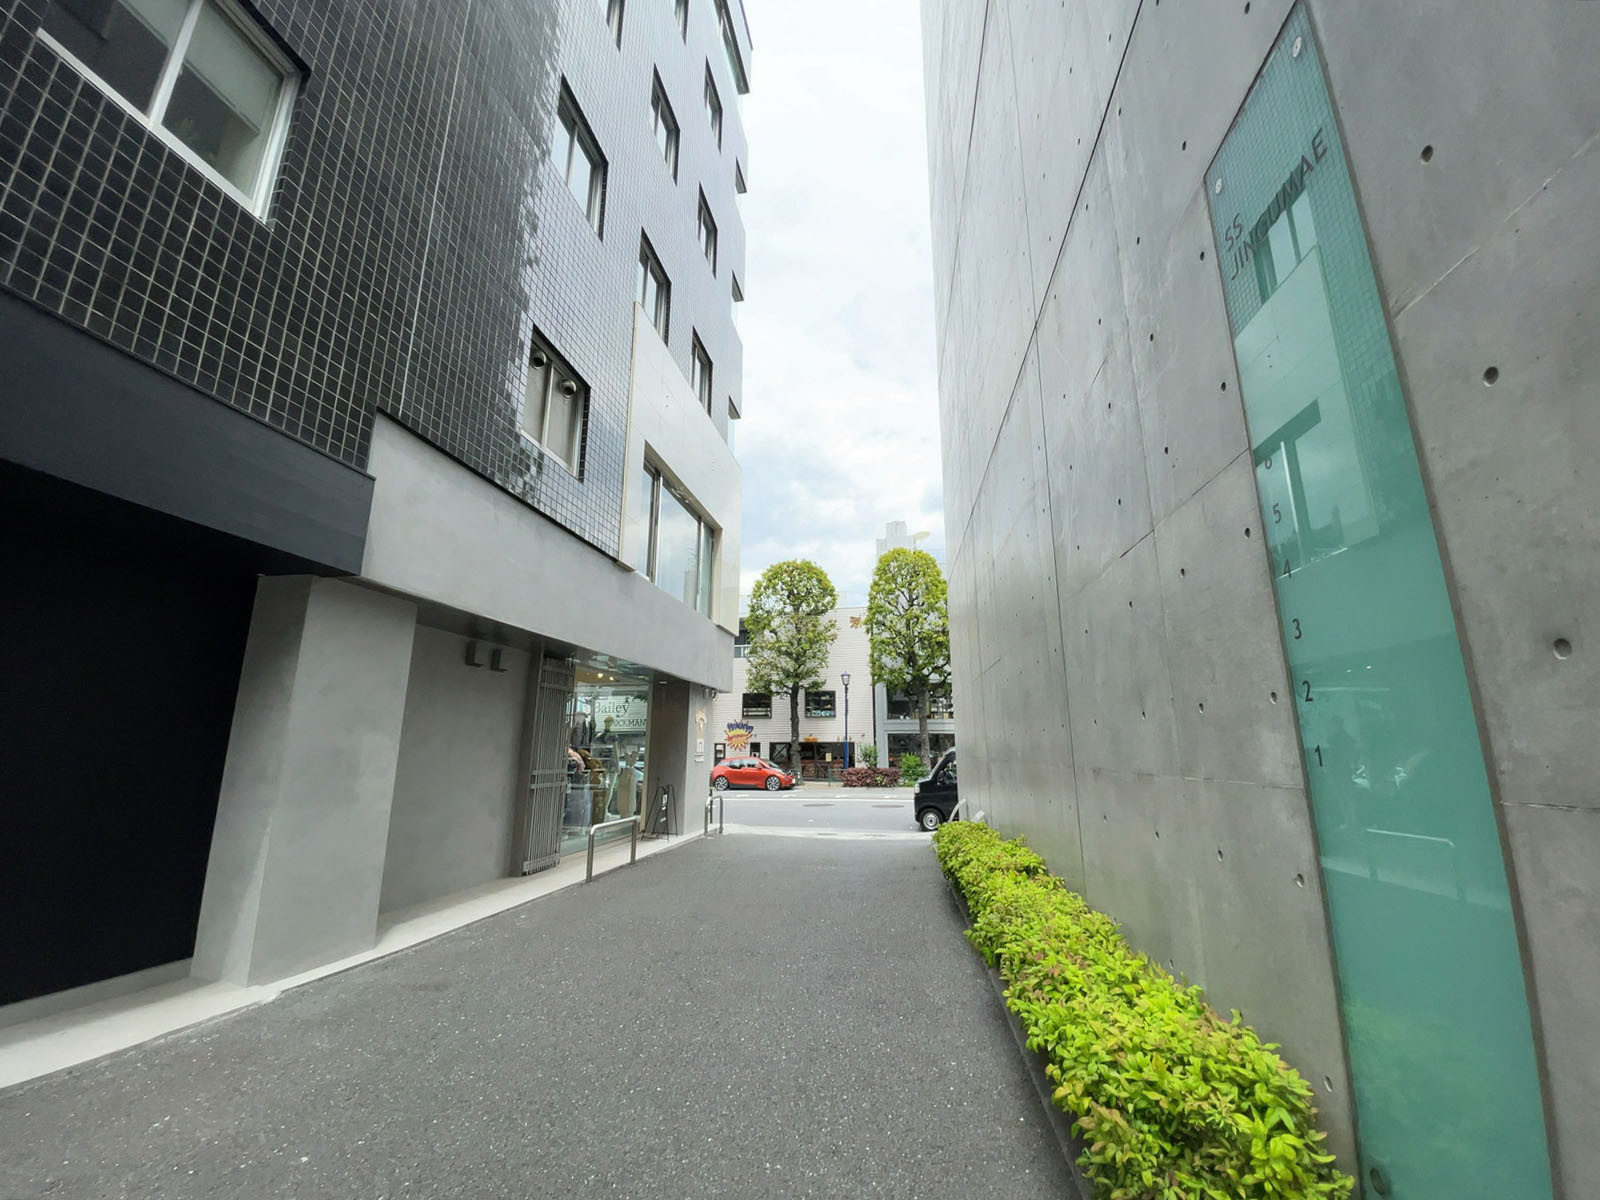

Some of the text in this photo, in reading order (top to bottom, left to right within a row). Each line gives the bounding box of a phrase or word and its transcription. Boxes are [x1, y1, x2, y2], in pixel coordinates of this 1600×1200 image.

[1231, 127, 1328, 281] JINGUMAE
[1225, 212, 1243, 253] SS
[1272, 503, 1282, 524] 5
[1283, 558, 1292, 579] 4
[1292, 618, 1302, 640] 3
[1302, 680, 1314, 703] 2
[595, 699, 630, 718] Bailey
[1314, 744, 1323, 767] 1
